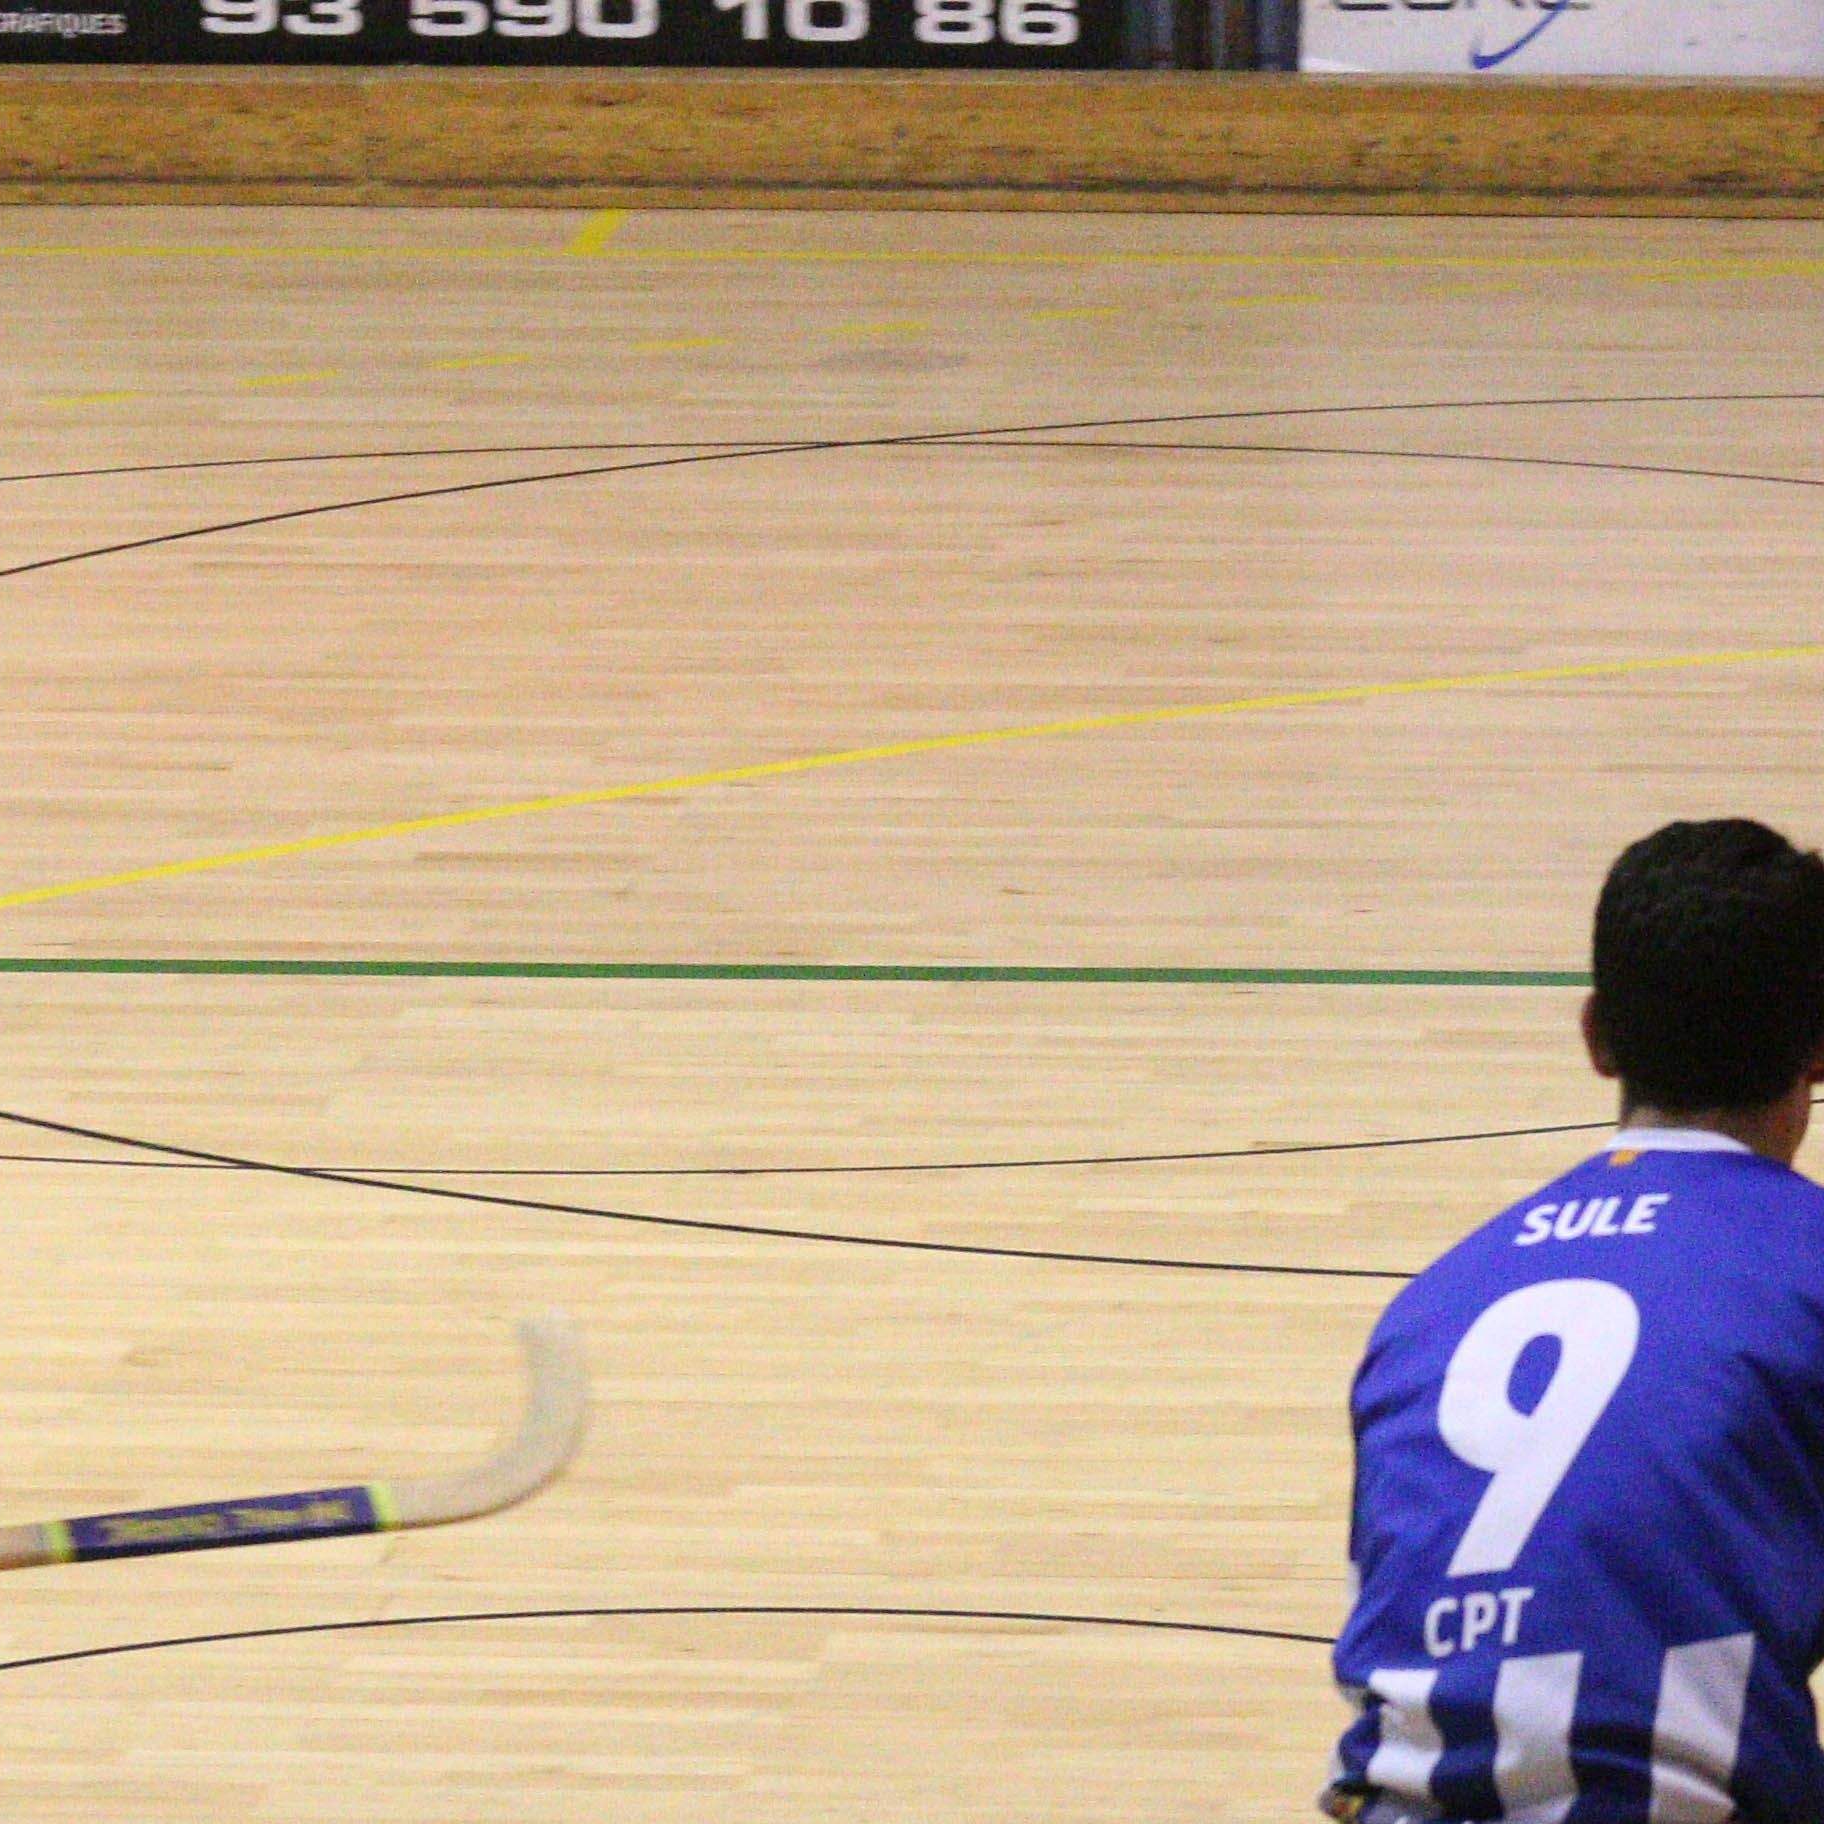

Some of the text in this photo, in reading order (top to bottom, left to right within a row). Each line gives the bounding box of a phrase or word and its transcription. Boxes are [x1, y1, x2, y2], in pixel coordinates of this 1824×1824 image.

[200, 0, 1080, 46] 93 590 10 86
[1514, 1193, 1672, 1247] SULE
[1436, 1277, 1641, 1578] 9
[1422, 1586, 1536, 1659] CPT
